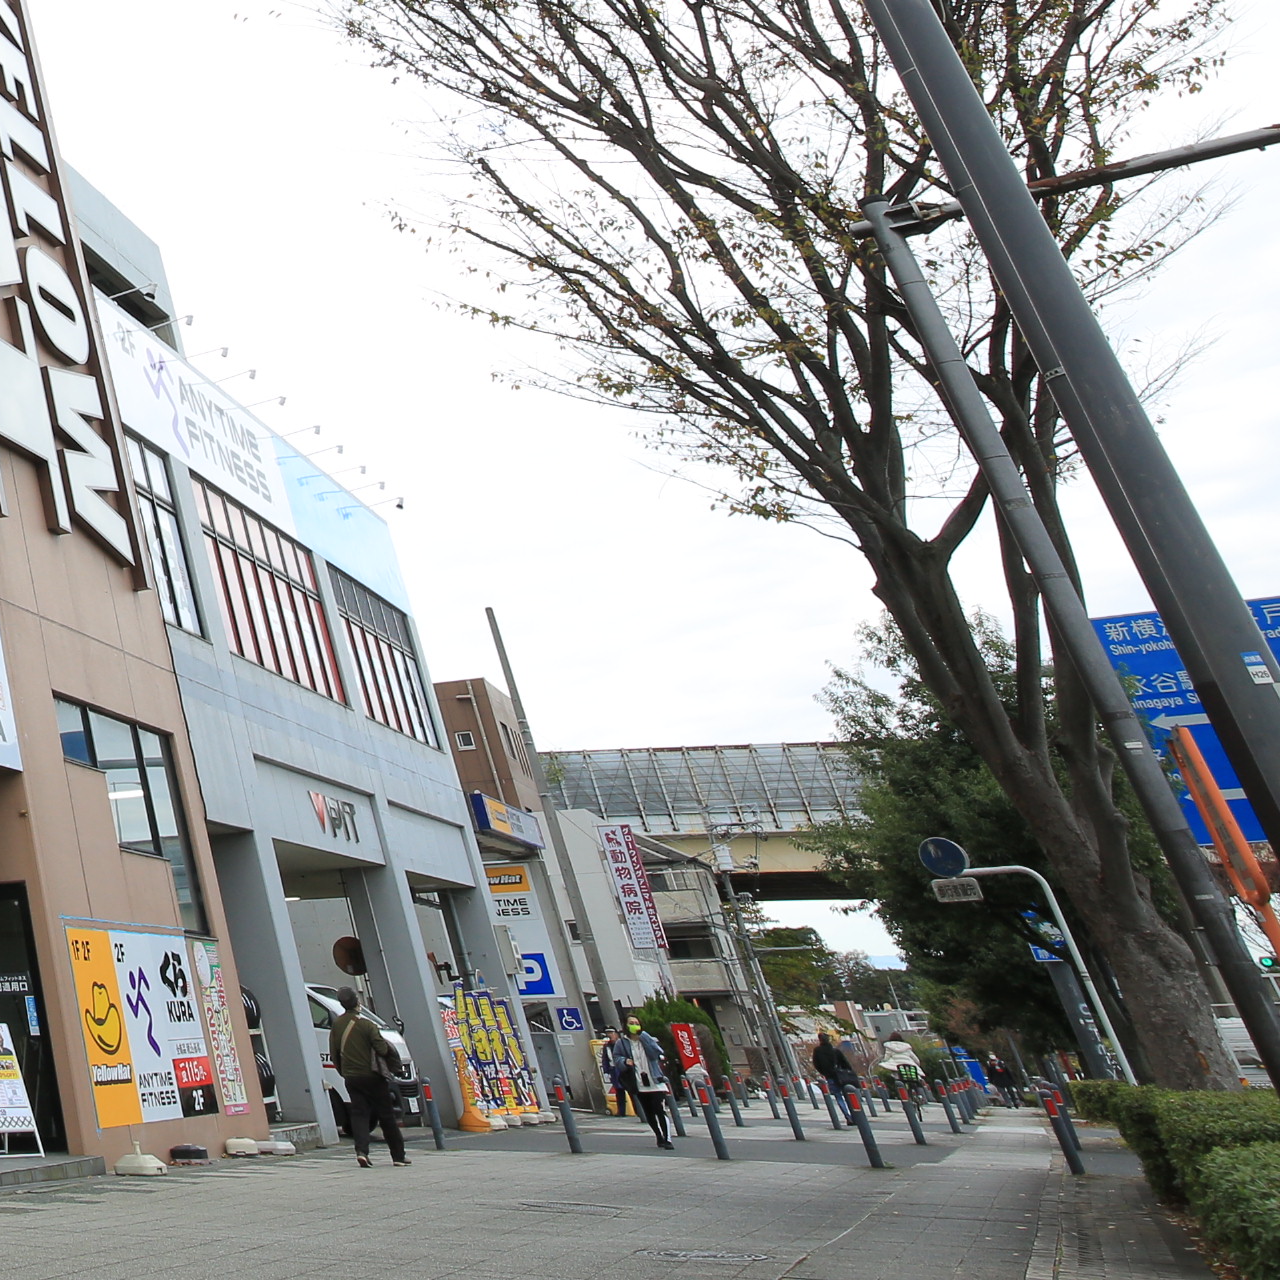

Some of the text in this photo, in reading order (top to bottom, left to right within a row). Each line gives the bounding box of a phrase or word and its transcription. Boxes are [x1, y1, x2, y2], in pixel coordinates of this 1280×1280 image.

[179, 375, 262, 463] ANYTIME
[184, 415, 272, 504] FITNESS
[1251, 671, 1270, 679] H26
[488, 873, 522, 887] wHat
[609, 849, 643, 916] 動物病院
[494, 898, 528, 907] TIME
[71, 940, 90, 961] 1F 2F
[114, 943, 125, 963] 2F
[160, 951, 188, 998] くら
[517, 959, 543, 991] P
[167, 1000, 195, 1023] KURA
[92, 1064, 132, 1086] YellowHat
[139, 1071, 174, 1089] ANYTIME
[141, 1090, 177, 1108] FITNESS
[193, 1090, 204, 1110] 2F
